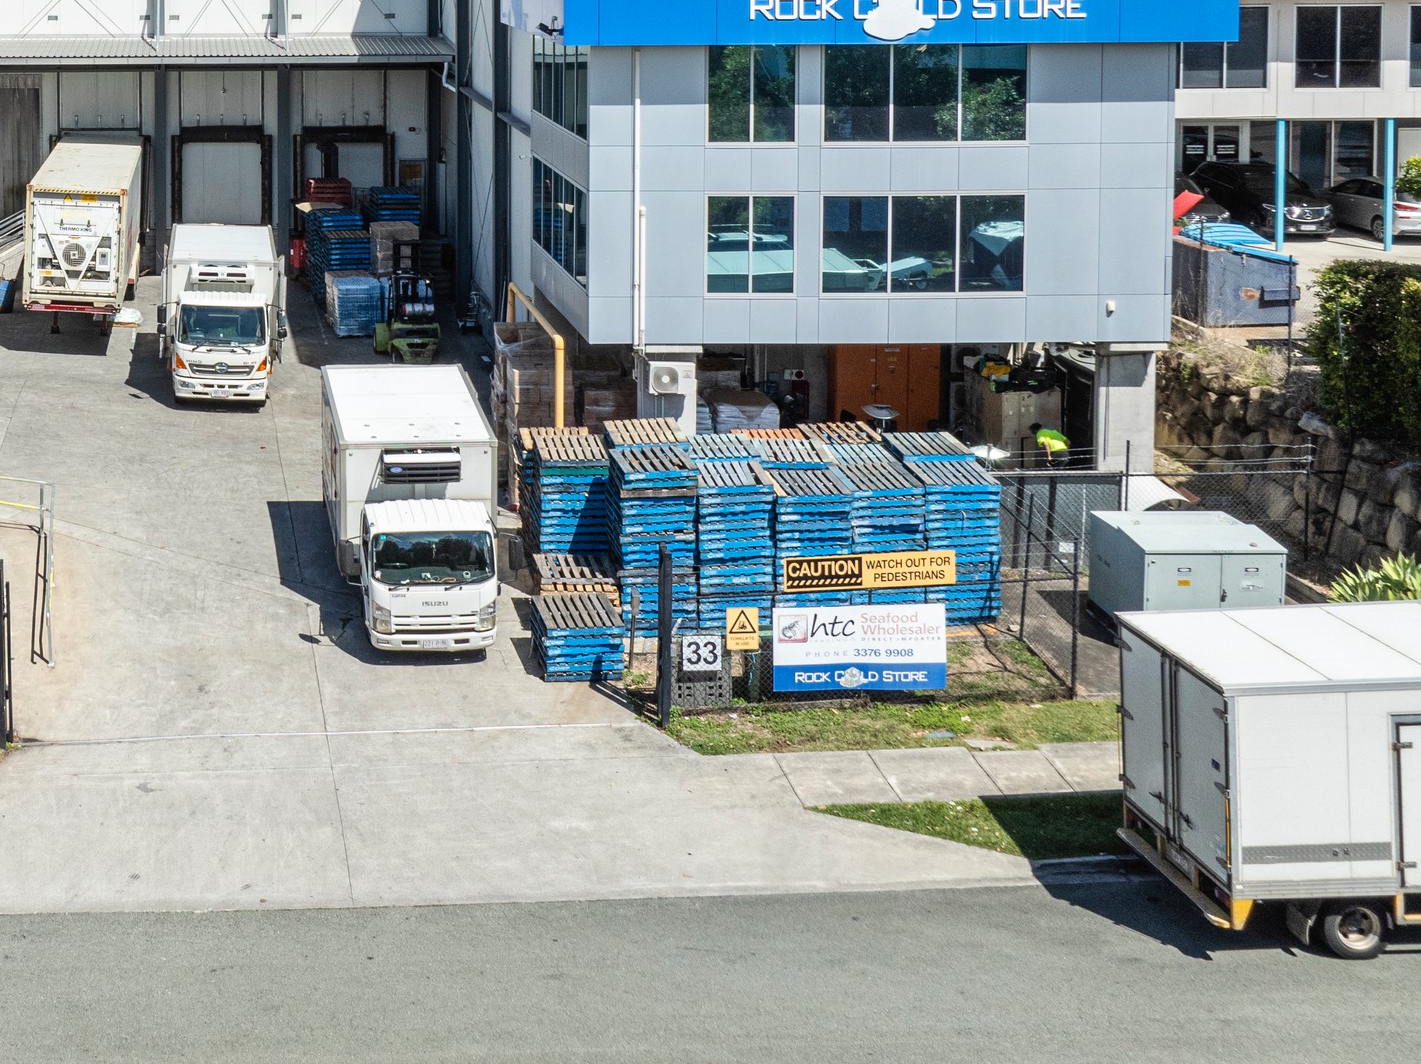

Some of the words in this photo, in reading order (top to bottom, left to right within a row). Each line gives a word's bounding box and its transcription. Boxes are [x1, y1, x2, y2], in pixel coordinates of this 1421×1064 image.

[788, 560, 859, 578] CAUTION
[866, 558, 902, 570] WATCH
[905, 558, 926, 569] OUT
[930, 557, 951, 567] FOR
[874, 570, 946, 582] PEDESTRIANS
[810, 613, 856, 638] htc
[861, 612, 918, 624] Seafood
[861, 624, 940, 635] Wholesaler
[687, 641, 718, 665] 33
[853, 649, 881, 657] 3376
[885, 649, 914, 657] 9908
[794, 672, 831, 683] ROCK
[883, 670, 928, 682] STORE
